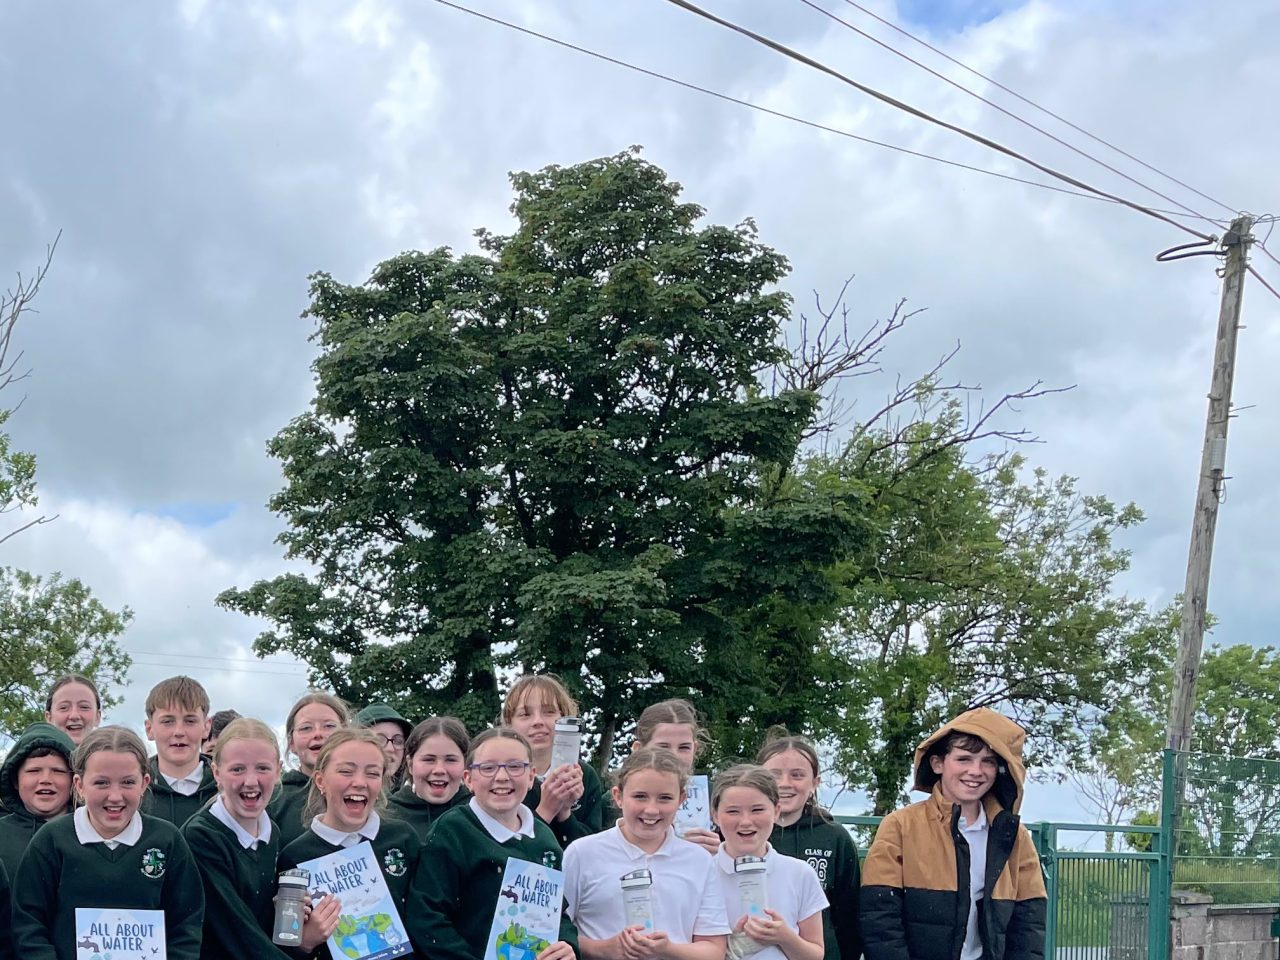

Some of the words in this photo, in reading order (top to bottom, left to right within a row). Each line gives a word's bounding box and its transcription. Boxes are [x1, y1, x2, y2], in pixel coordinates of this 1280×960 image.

[824, 850, 833, 858] OF
[314, 871, 330, 886] ALL
[334, 857, 369, 880] ABOUT
[327, 874, 364, 894] WATER
[514, 874, 531, 890] ALL
[534, 878, 559, 897] ABOUT
[521, 889, 550, 908] WATER
[90, 922, 110, 936] ALL
[116, 923, 154, 938] ABOUT
[102, 937, 143, 951] WATER
